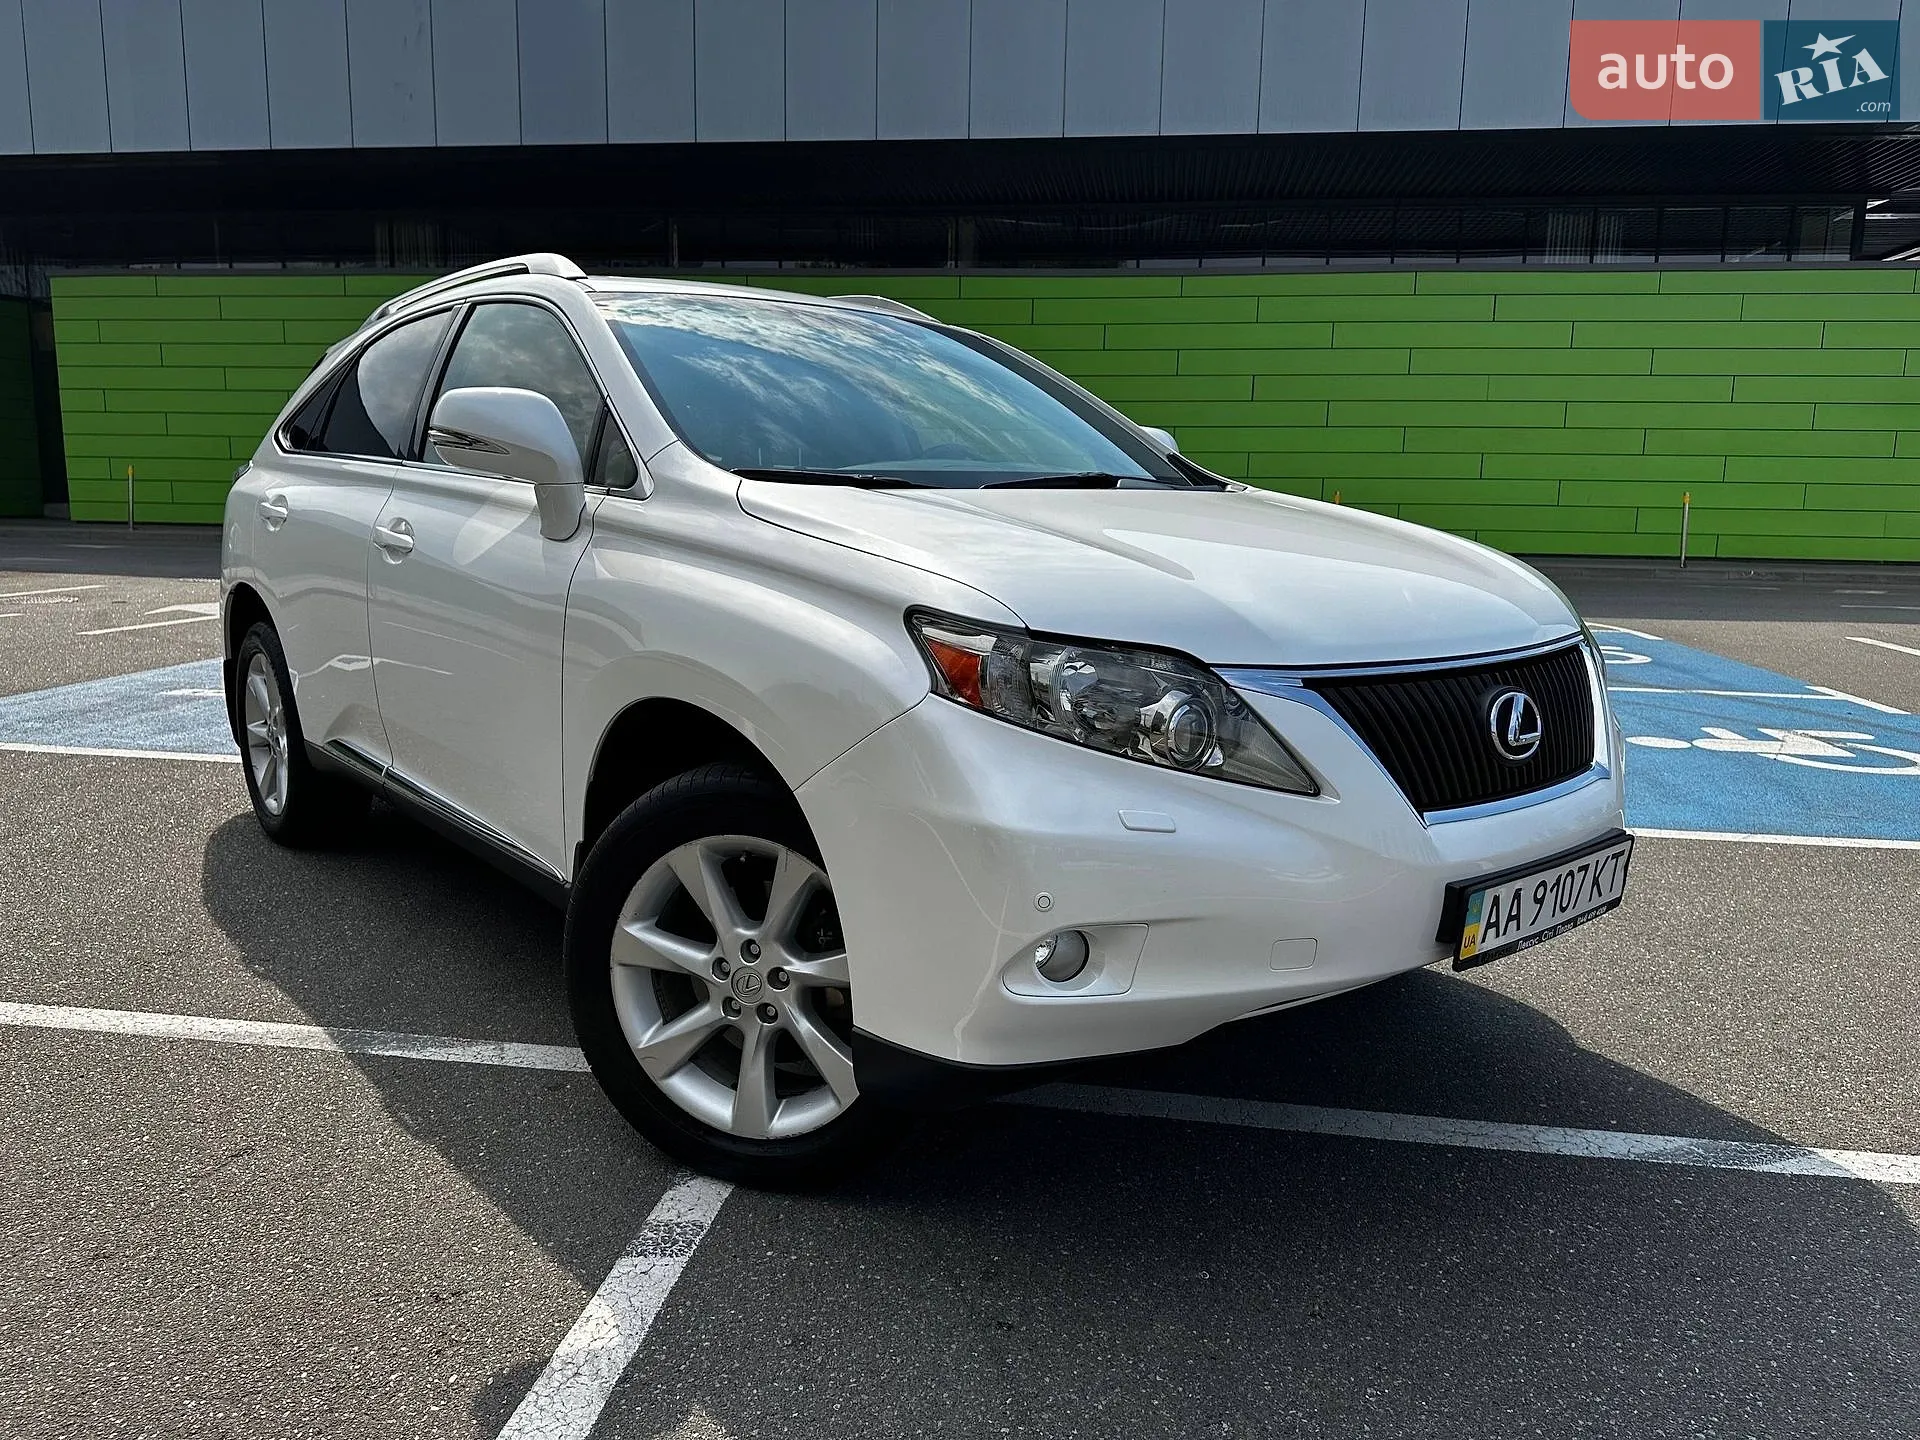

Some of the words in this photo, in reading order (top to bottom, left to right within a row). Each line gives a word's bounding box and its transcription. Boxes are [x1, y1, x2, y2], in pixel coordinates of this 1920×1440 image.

[1481, 887, 1523, 944] AA
[1529, 863, 1591, 927] 9107
[1589, 849, 1625, 902] KT
[1464, 934, 1476, 948] UA
